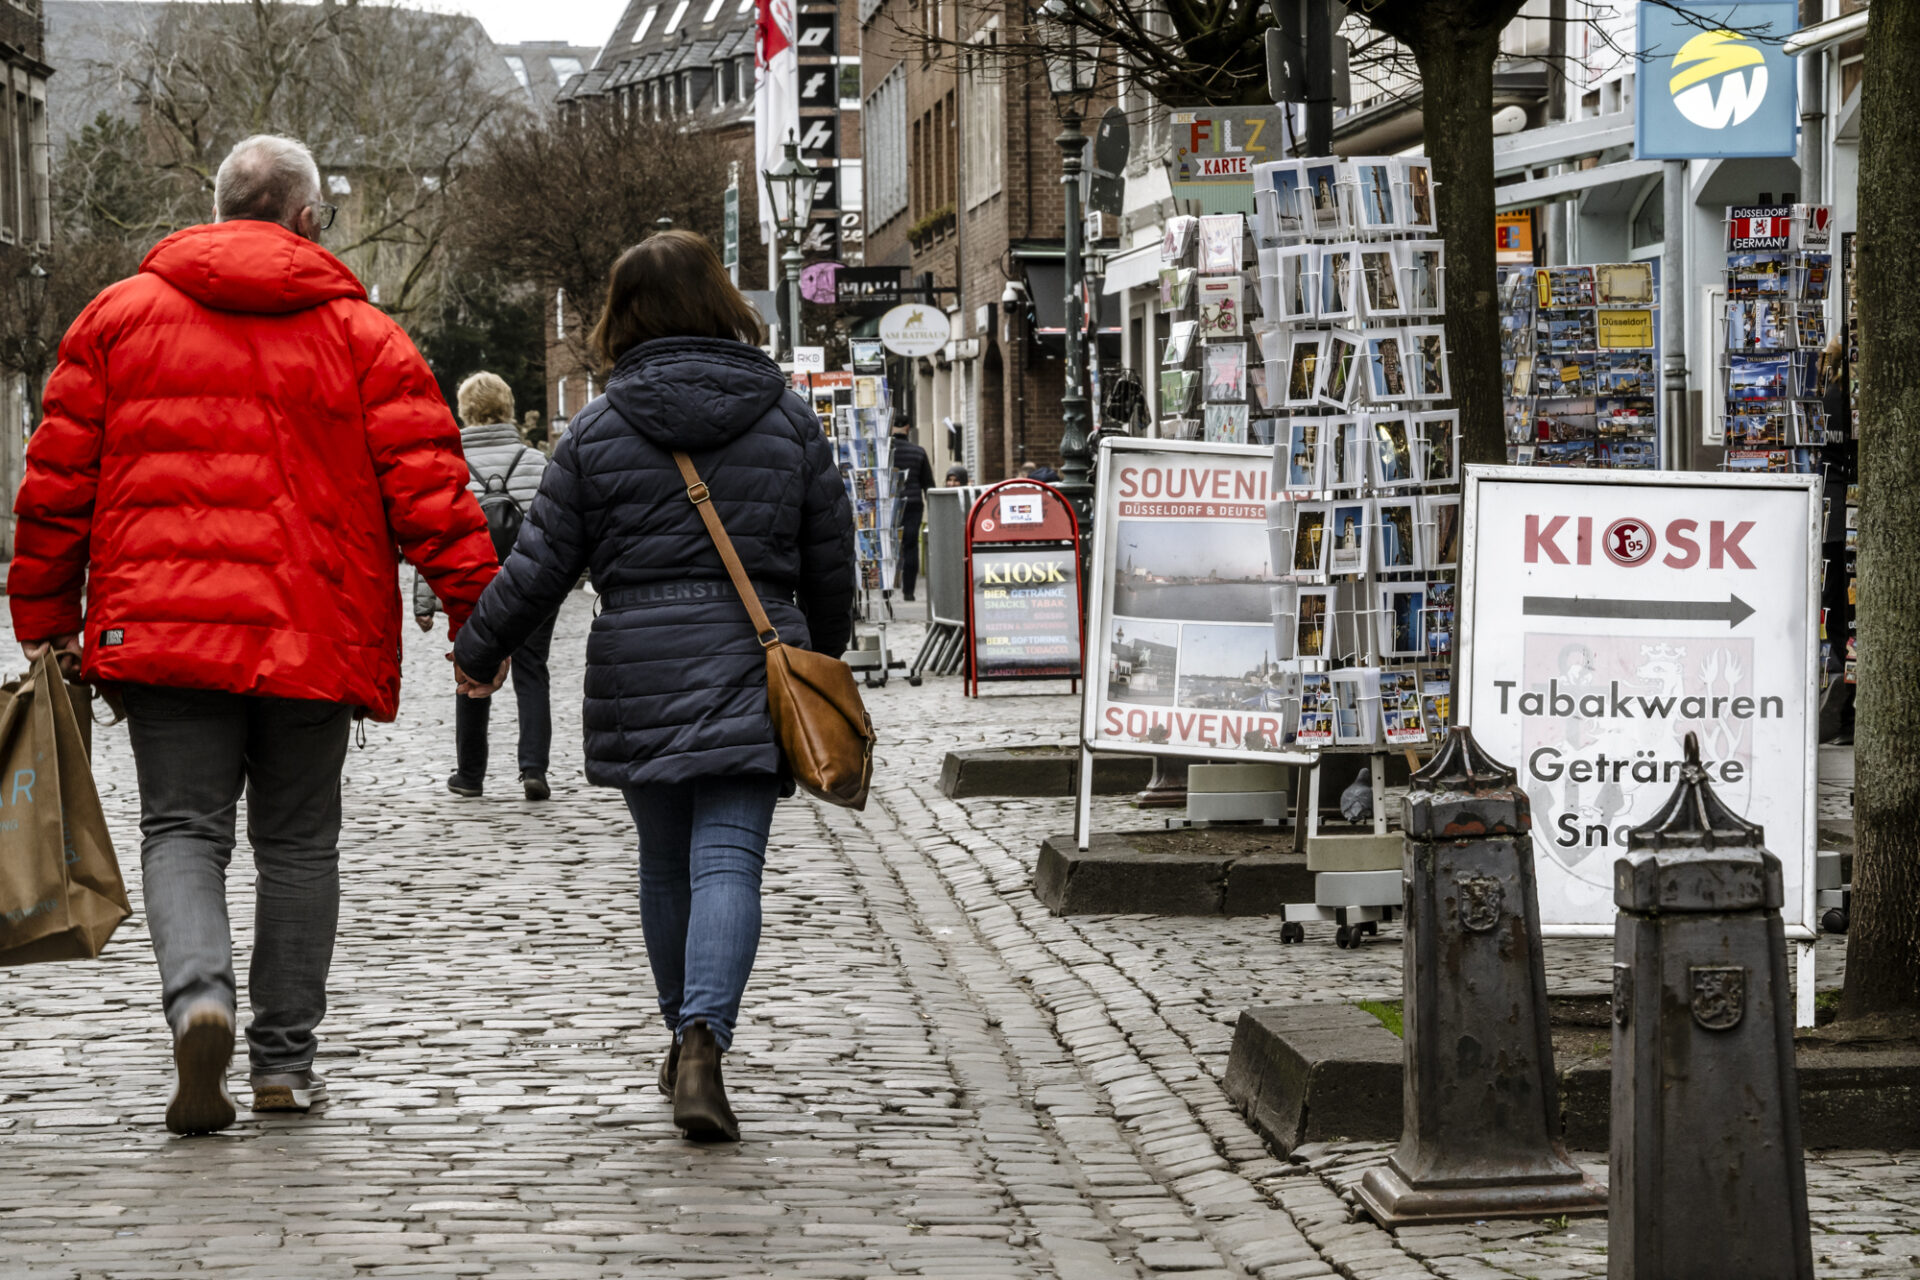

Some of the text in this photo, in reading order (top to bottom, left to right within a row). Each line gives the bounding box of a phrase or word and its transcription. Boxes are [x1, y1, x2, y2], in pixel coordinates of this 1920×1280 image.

[1191, 119, 1266, 153] FILZ
[1204, 157, 1247, 175] KARTE
[1734, 207, 1789, 218] DÜSSELDORF
[1809, 207, 1815, 229] I
[1733, 237, 1787, 248] GERMANY
[1602, 317, 1648, 326] Düsseldorf
[902, 330, 946, 339] RATHAUS
[1119, 467, 1313, 501] SOUVENI
[1125, 503, 1265, 518] DÜSSELDORF & DEUTSC
[1523, 514, 1757, 570] KIOSK
[984, 561, 1067, 584] KIOSK
[984, 587, 1067, 600] BIER, GETRÄNKE,
[1494, 679, 1784, 719] Tabakwaren
[0, 768, 36, 807] R
